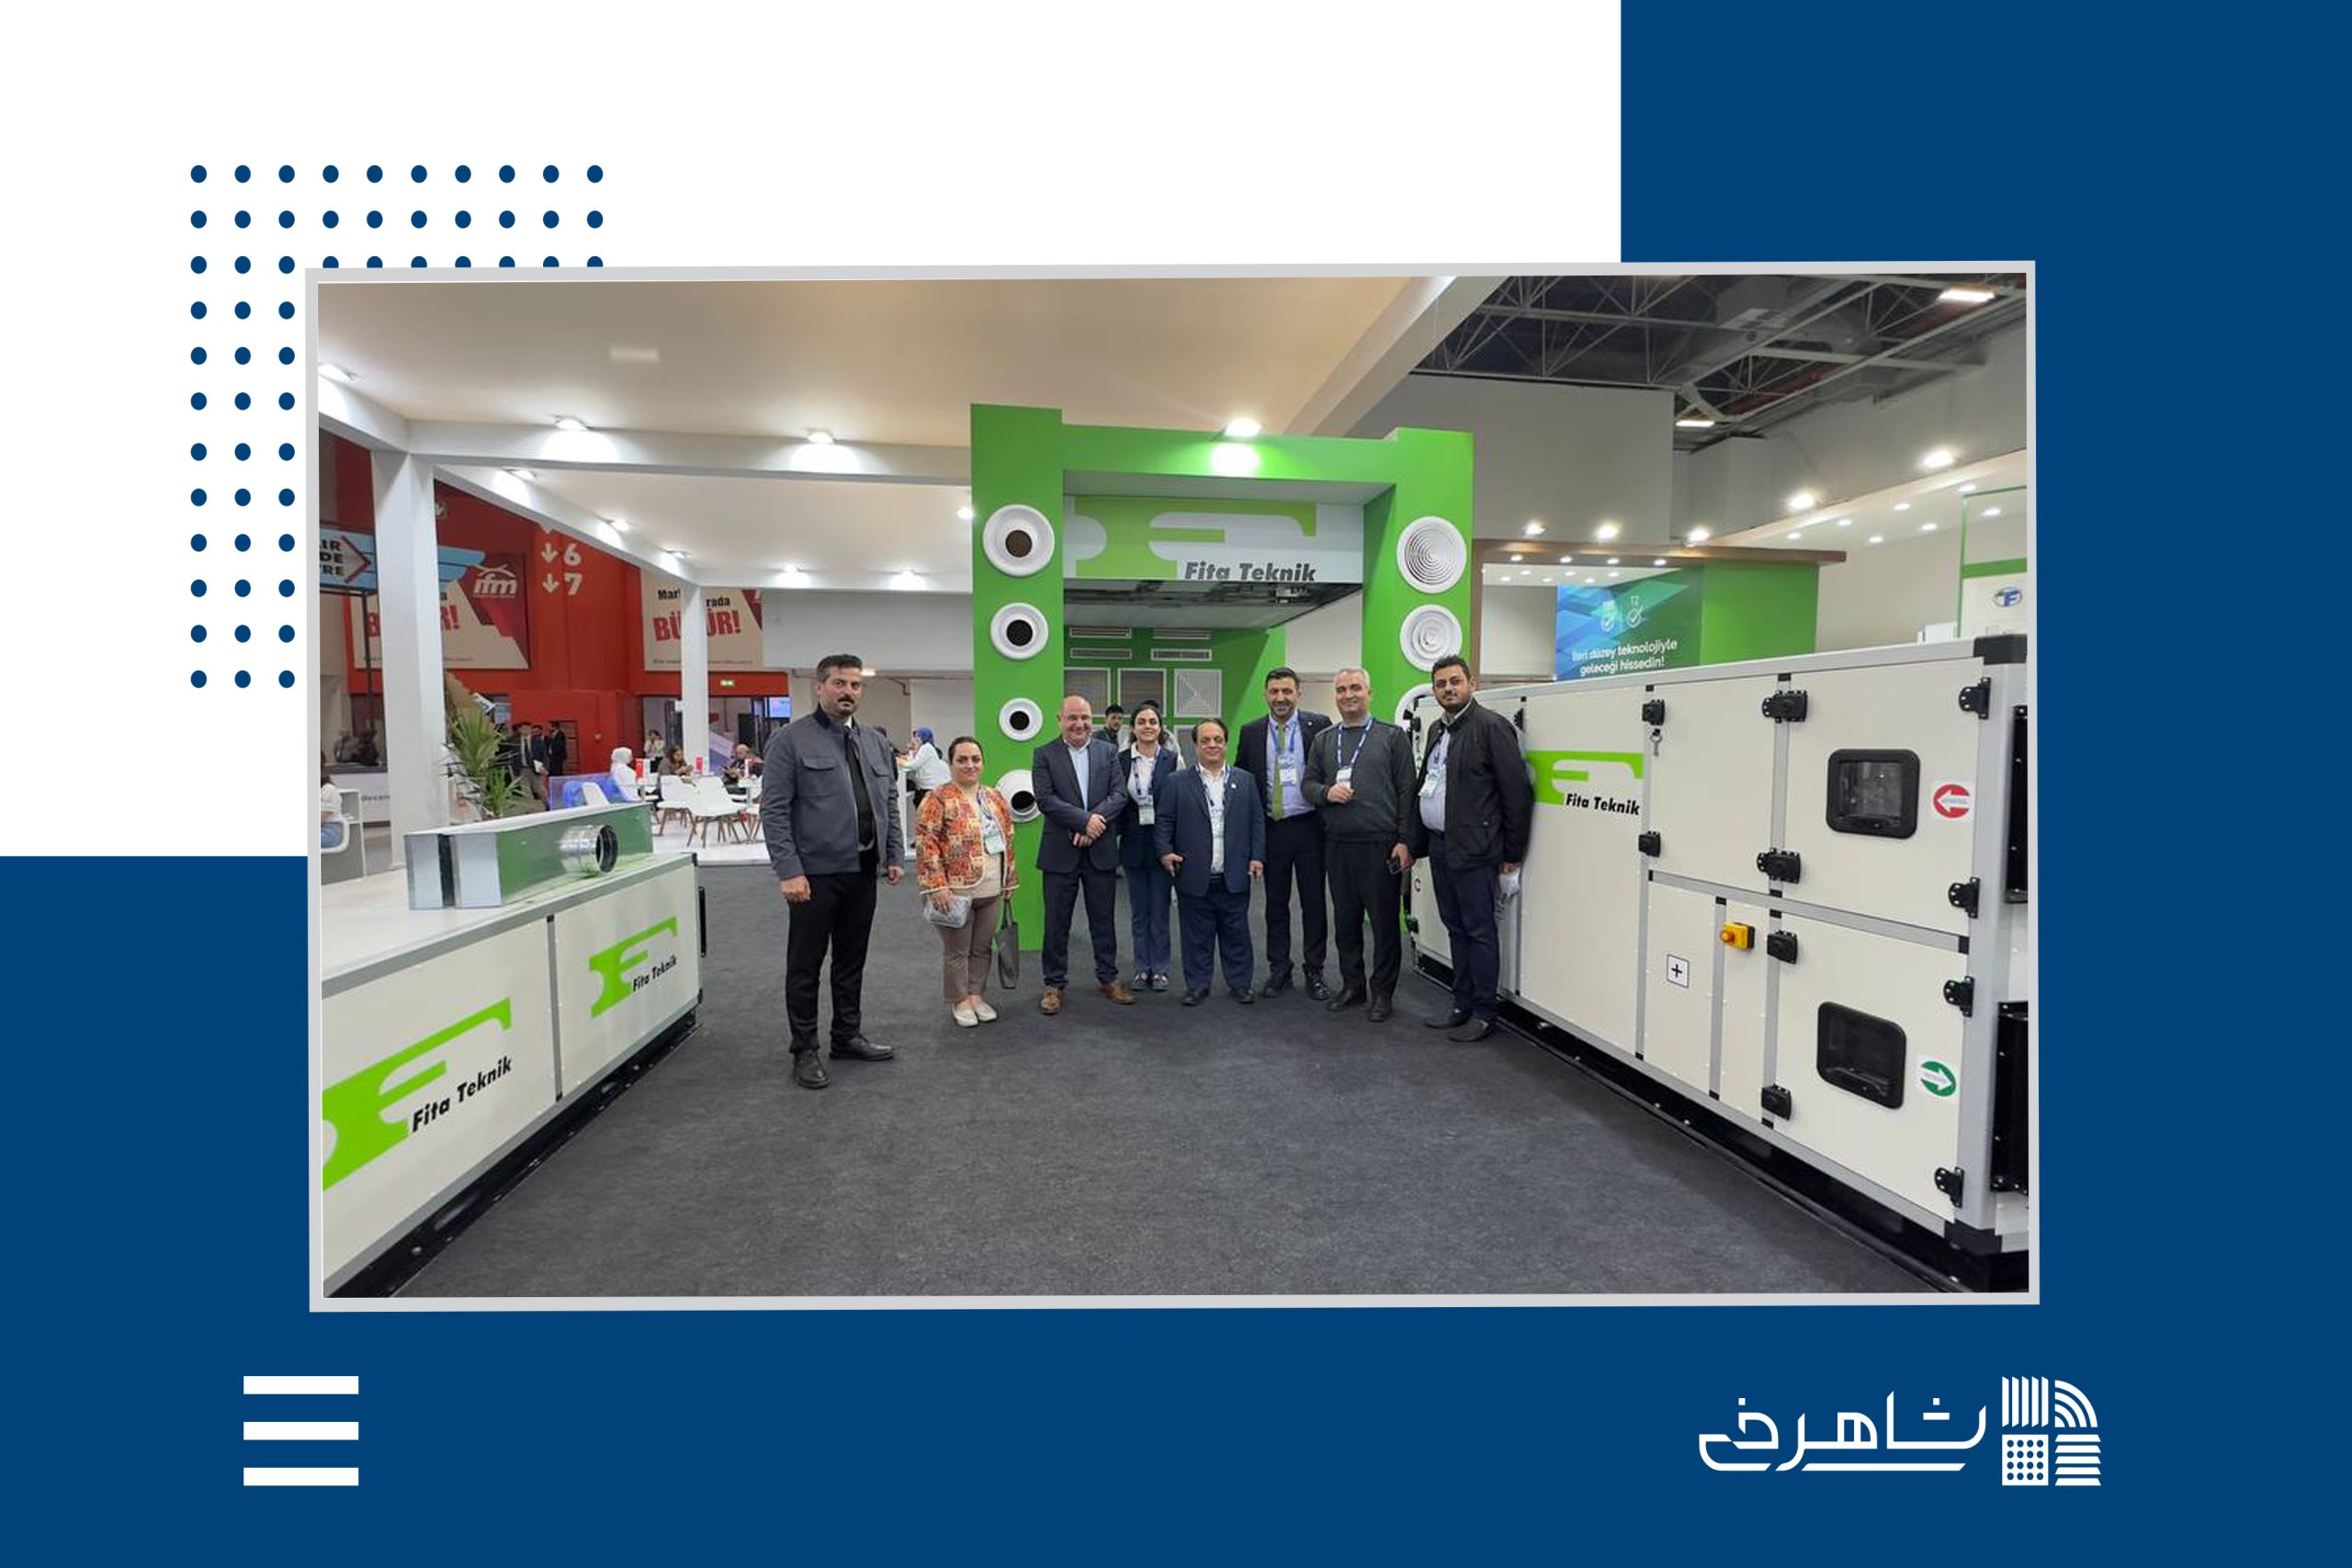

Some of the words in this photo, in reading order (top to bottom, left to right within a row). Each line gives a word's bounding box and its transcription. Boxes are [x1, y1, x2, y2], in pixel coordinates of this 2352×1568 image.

[320, 539, 341, 551] IR
[563, 542, 582, 567] 6
[320, 552, 344, 564] DE
[320, 565, 345, 576] RE
[1184, 560, 1231, 580] Fita
[1238, 562, 1317, 581] Teknik
[473, 572, 517, 595] ifm
[563, 572, 582, 596] 7
[706, 596, 730, 607] rada
[653, 609, 741, 641] BÜÜR!
[1566, 793, 1589, 808] Fita
[1594, 796, 1640, 816] Teknik
[633, 974, 650, 992] Fita
[651, 954, 677, 980] Teknik
[412, 1098, 451, 1133] Fita
[457, 1055, 512, 1104] Teknik
